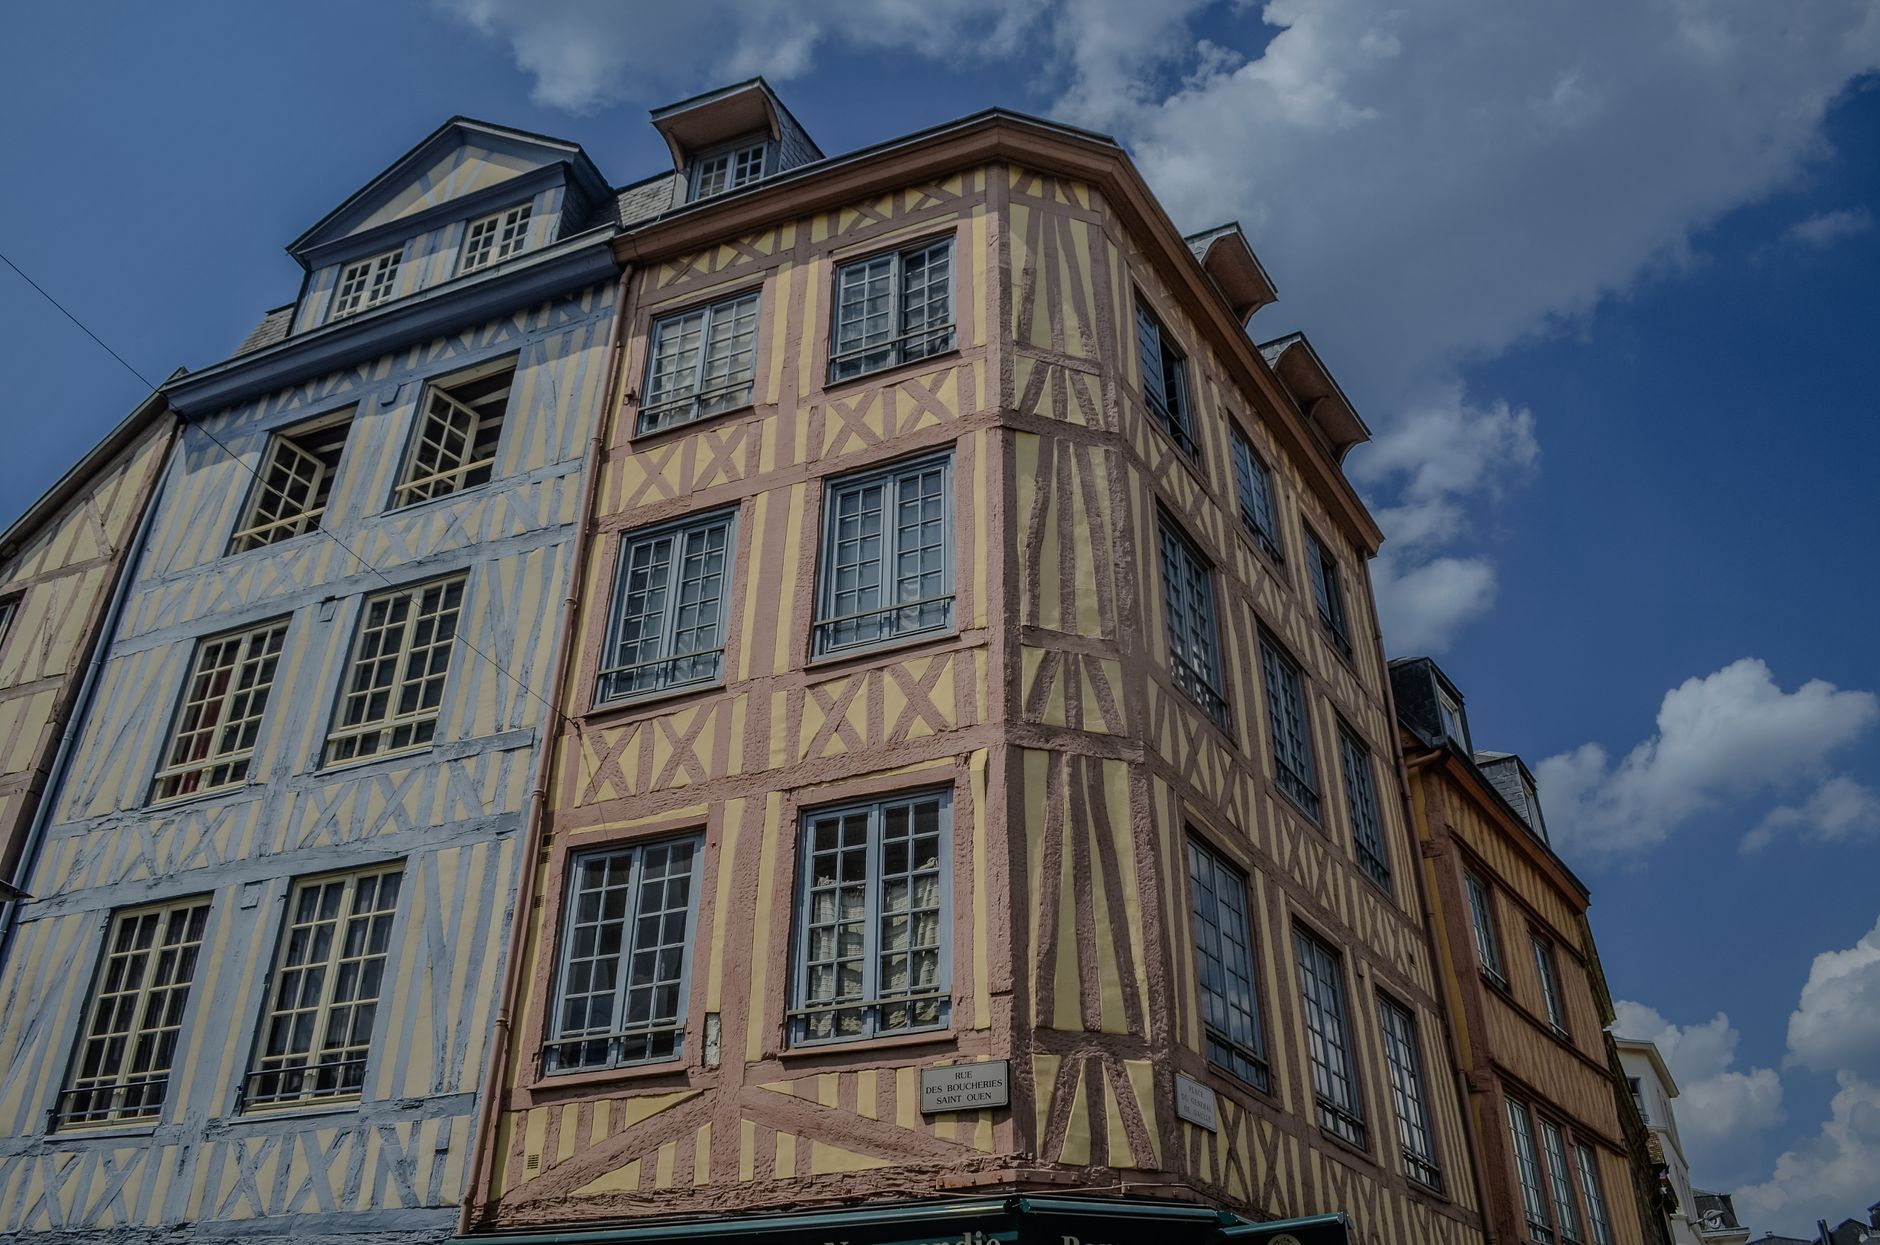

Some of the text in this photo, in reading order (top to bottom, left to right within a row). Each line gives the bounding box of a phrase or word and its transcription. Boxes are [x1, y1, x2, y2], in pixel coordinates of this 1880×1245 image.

[955, 1071, 973, 1080] RUE
[926, 1079, 1003, 1094] DES BOUCHERIES
[1188, 1085, 1203, 1098] PLACE
[936, 1092, 992, 1105] SAINT OUEN
[1183, 1104, 1191, 1113] DE
